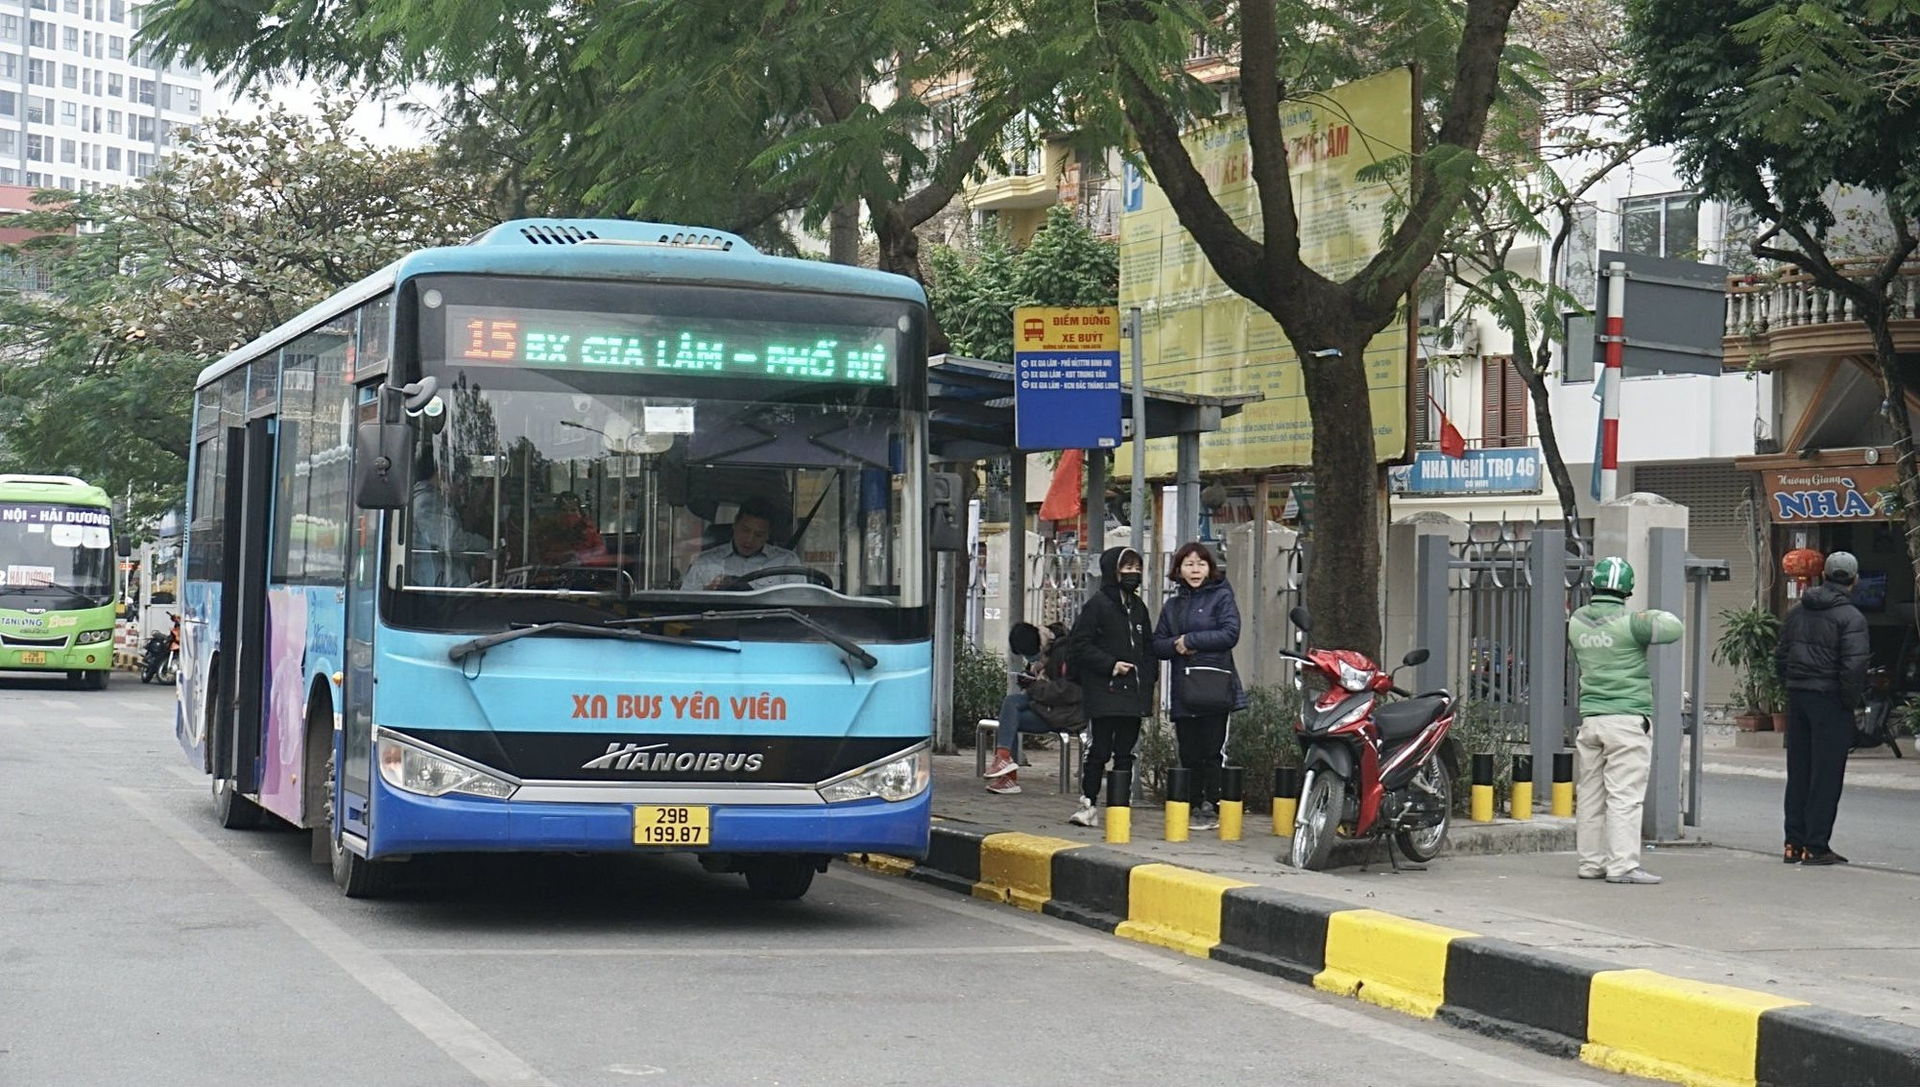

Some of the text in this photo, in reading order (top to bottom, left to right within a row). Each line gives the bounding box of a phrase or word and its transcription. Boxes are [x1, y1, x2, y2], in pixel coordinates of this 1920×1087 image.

[463, 319, 517, 360] 15
[525, 332, 571, 363] BX
[580, 336, 645, 367] GIA
[656, 332, 723, 371] LÂM
[1062, 331, 1104, 343] XE BUÝT
[1421, 453, 1535, 480] NHÀ NGHỈ TRỌ 46
[1774, 477, 1876, 519] NHÀ
[3, 507, 27, 523] NỘI
[66, 511, 111, 526] DƯƠNG
[1579, 630, 1614, 648] Grab
[572, 691, 786, 720] XN BUS YÊN VIÊN
[581, 742, 764, 772] HANOIBUS
[656, 808, 688, 824] 29B
[644, 827, 701, 843] 199.87
